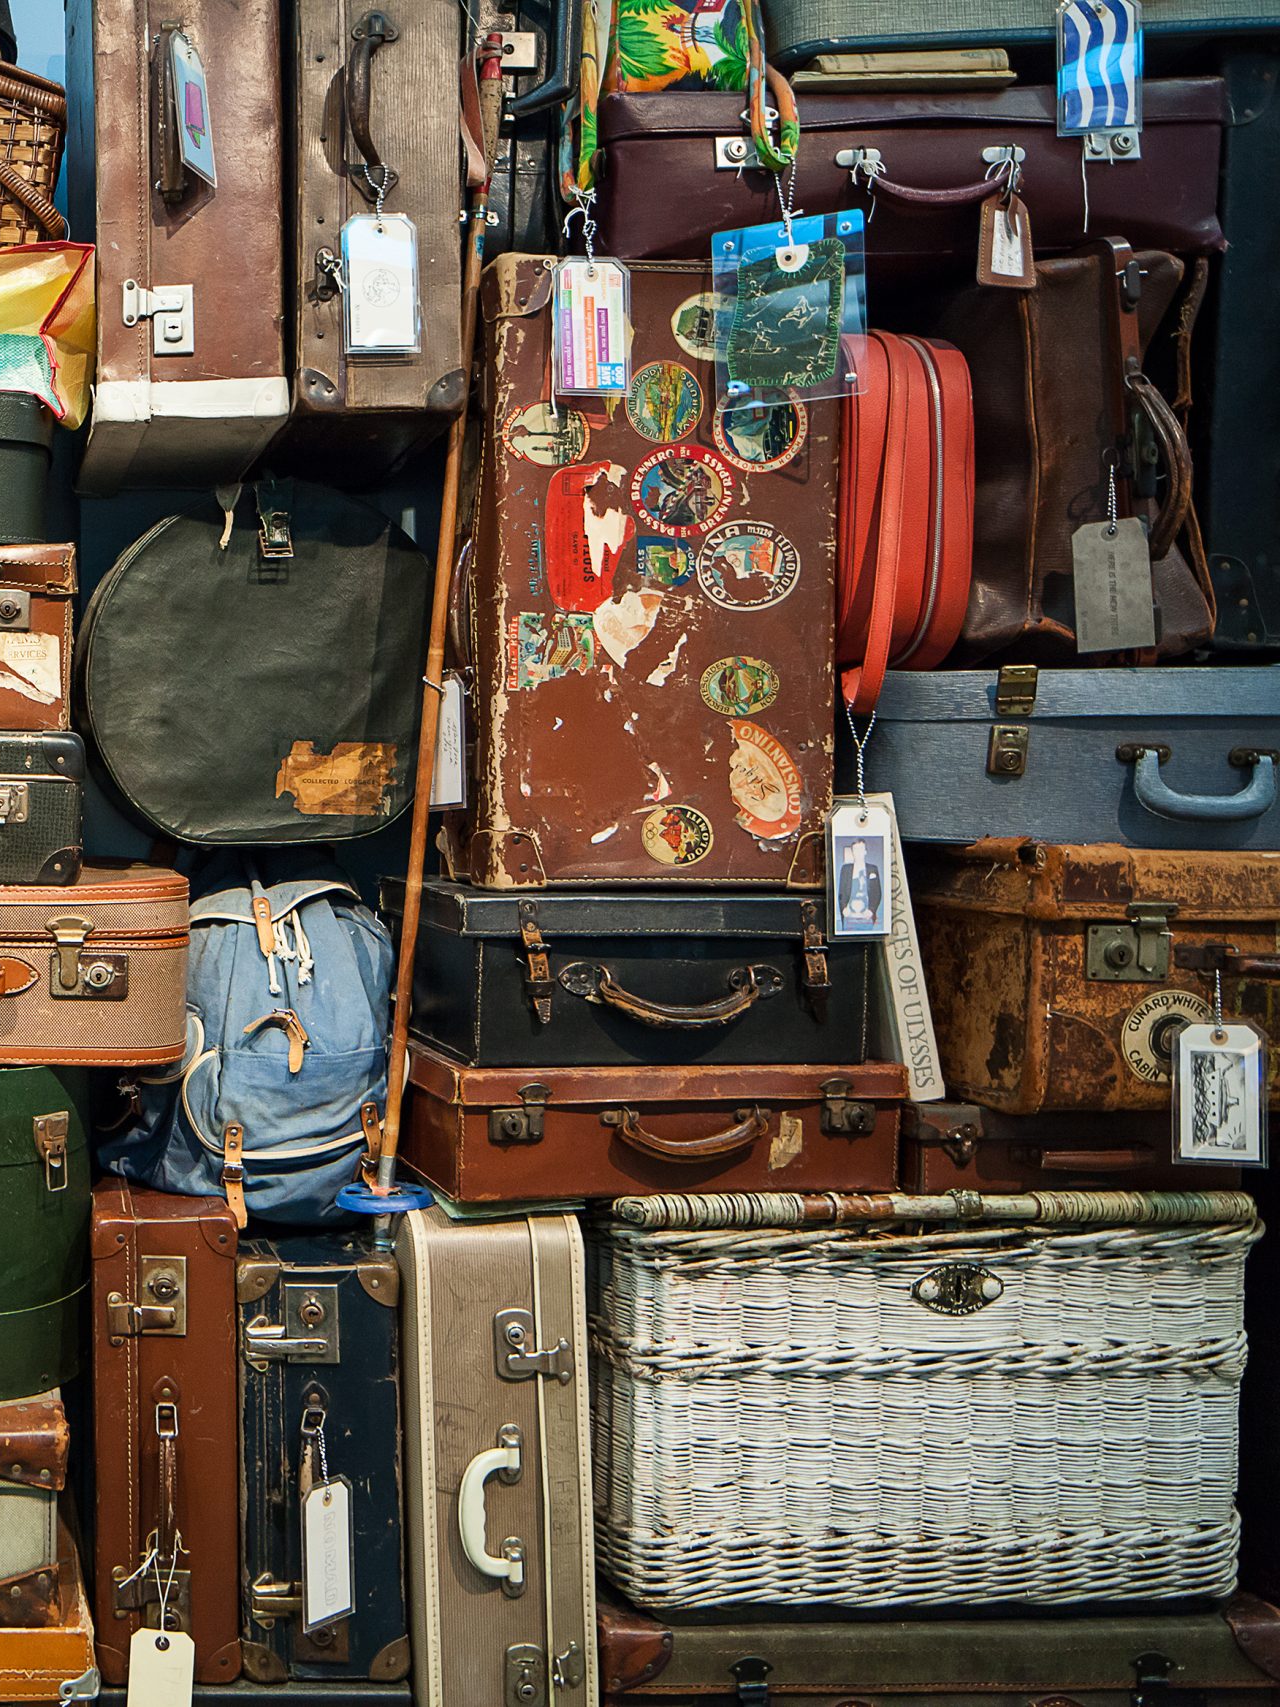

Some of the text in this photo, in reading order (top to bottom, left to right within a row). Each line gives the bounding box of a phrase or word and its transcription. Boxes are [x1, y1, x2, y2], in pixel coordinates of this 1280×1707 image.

[601, 366, 610, 386] SAVE
[631, 448, 675, 501] BRENNERO
[637, 510, 676, 537] PASSO
[686, 546, 697, 578] TYROL
[701, 524, 740, 606] CORTINA
[774, 534, 796, 594] DOLOMITI
[9, 649, 48, 659] ERVICES
[739, 725, 802, 815] CONSTANTINO
[686, 811, 710, 862] DOLOMITI
[897, 966, 918, 993] OF
[1128, 995, 1209, 1033] CUNARD WHITE
[903, 1002, 935, 1089] ULYSSES
[1129, 1049, 1161, 1081] CABIN
